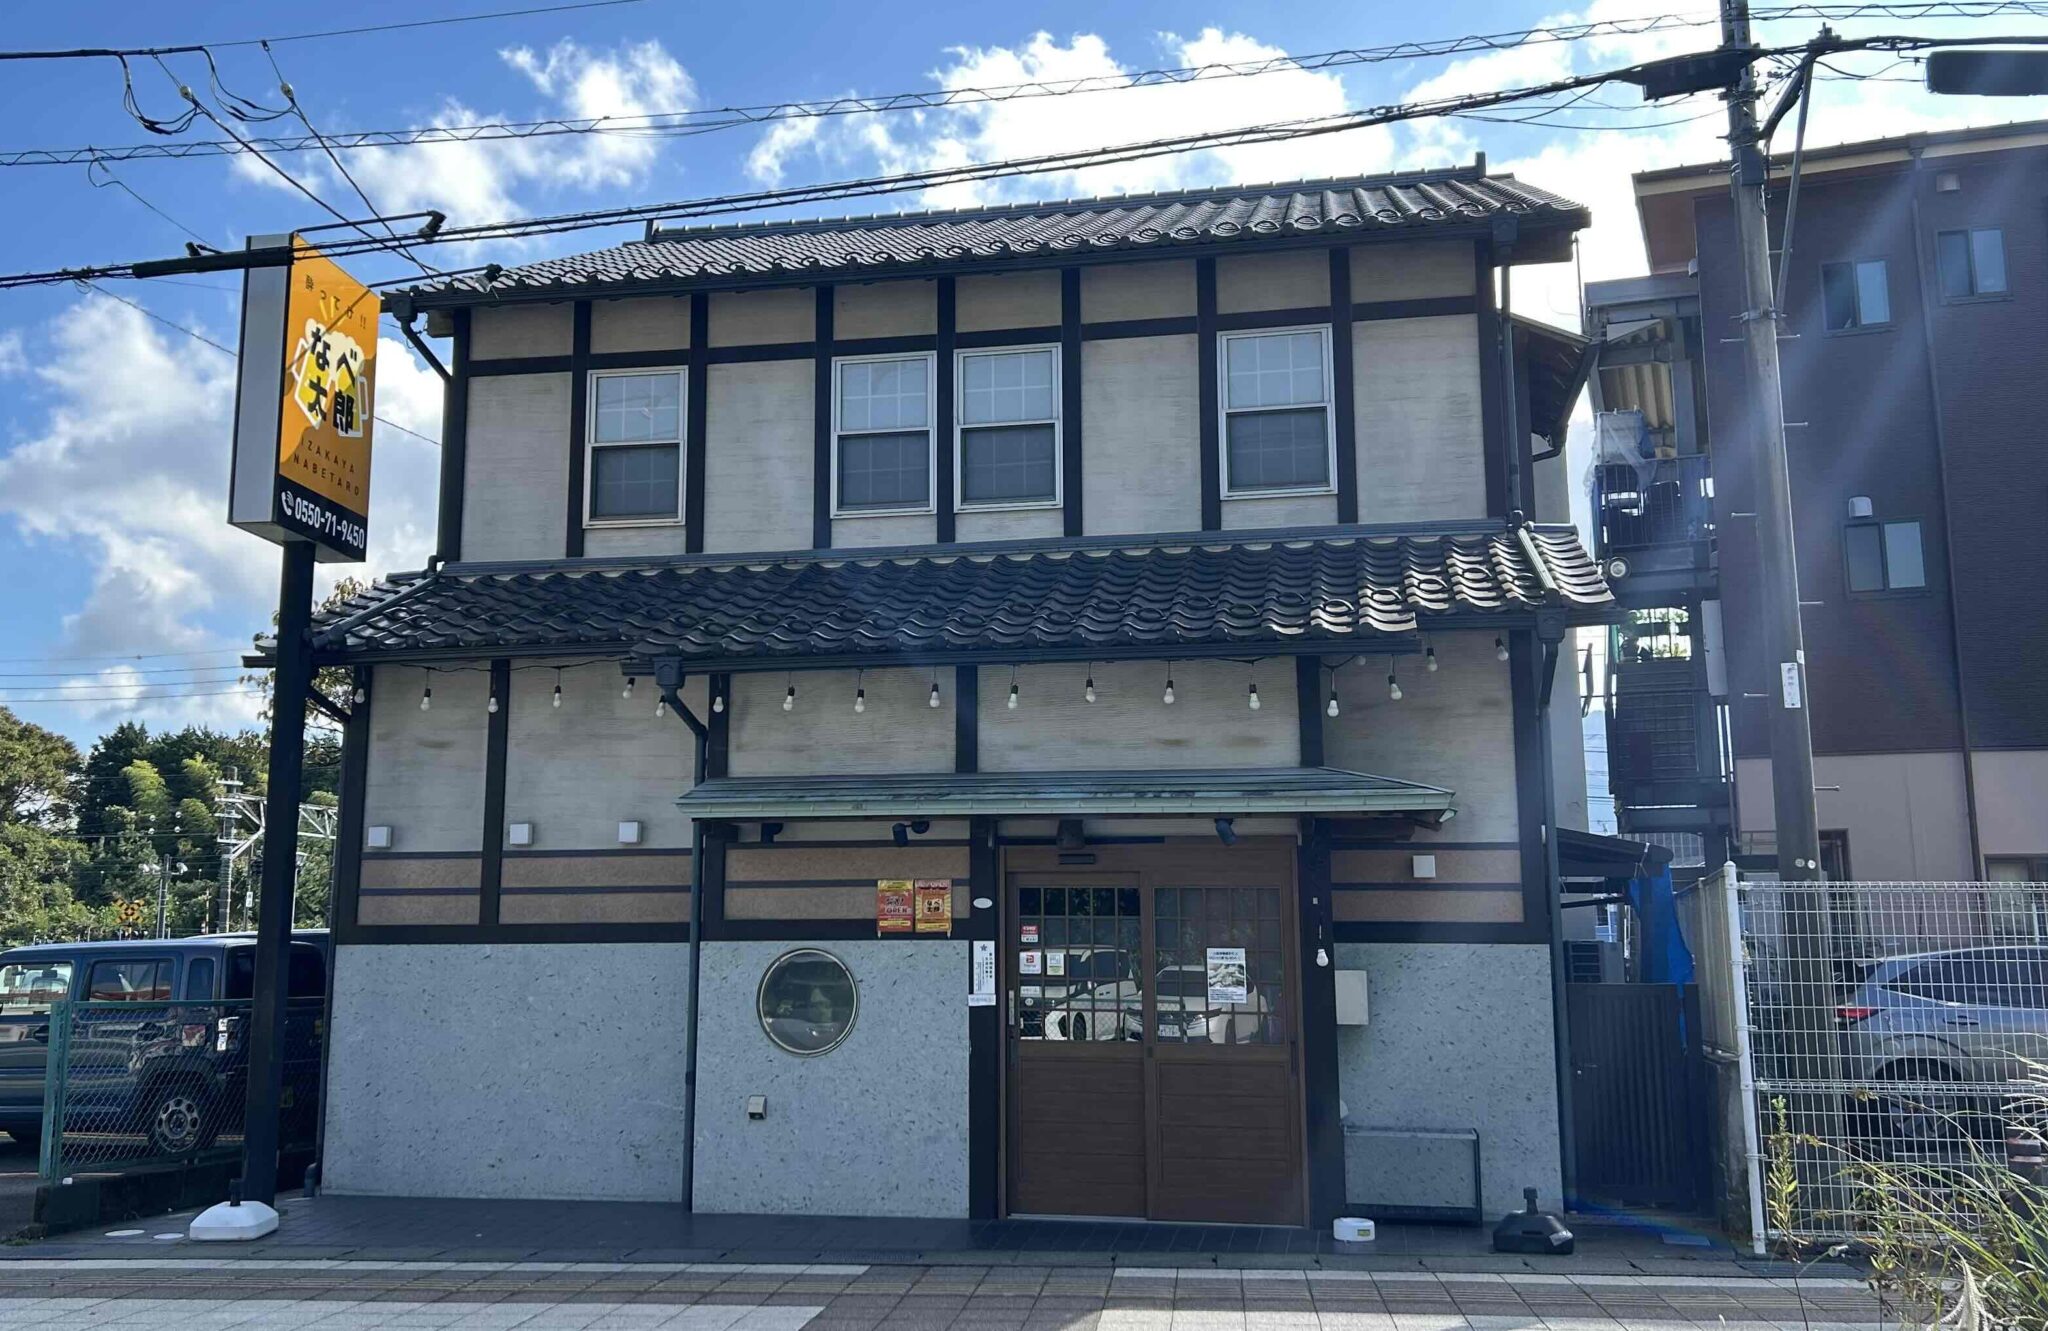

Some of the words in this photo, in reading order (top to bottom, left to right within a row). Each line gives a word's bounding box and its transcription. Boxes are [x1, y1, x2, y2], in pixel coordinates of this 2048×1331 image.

[311, 327, 357, 388] なべ
[308, 376, 354, 434] 太郎
[293, 454, 360, 496] NABETARO
[301, 437, 355, 473] IZAKAYA
[294, 497, 365, 549] 0550-71-9450
